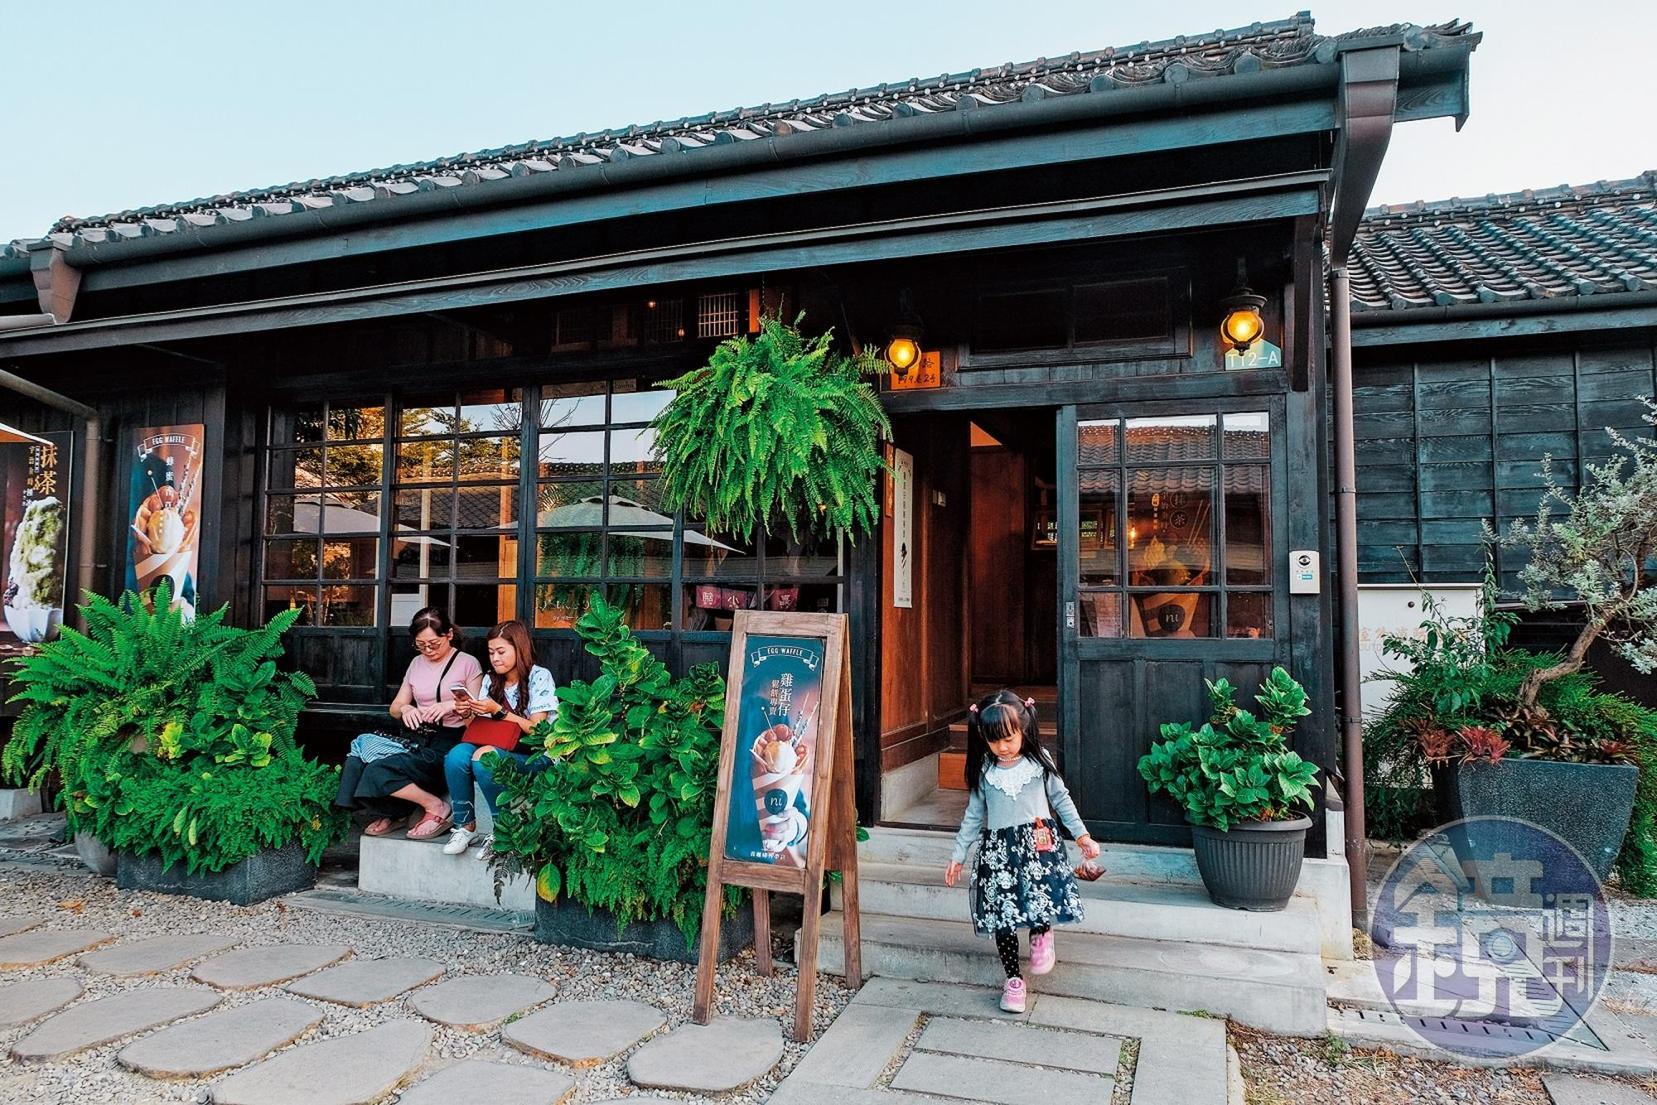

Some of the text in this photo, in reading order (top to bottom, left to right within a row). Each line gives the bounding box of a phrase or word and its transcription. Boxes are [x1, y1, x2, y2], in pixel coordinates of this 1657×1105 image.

[39, 446, 58, 495] 抹茶
[781, 648, 803, 656] WAFFLE
[778, 673, 794, 717] 雞蛋仔
